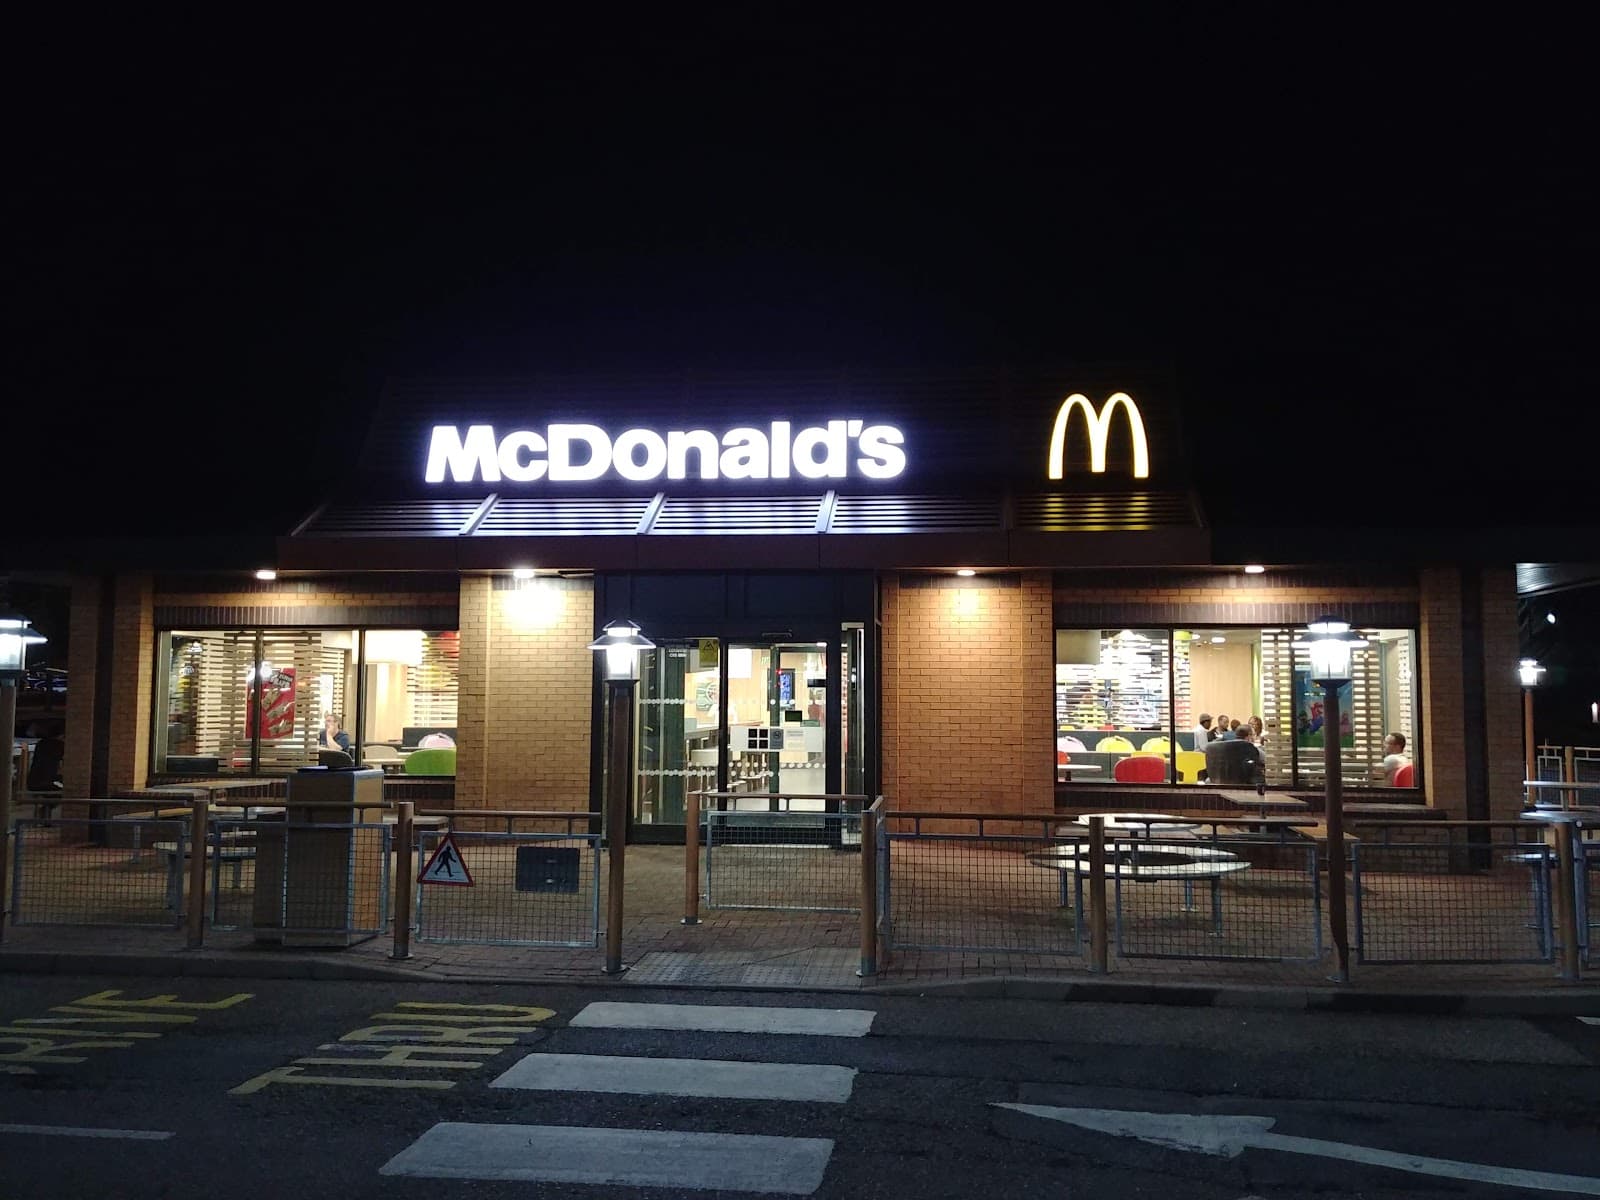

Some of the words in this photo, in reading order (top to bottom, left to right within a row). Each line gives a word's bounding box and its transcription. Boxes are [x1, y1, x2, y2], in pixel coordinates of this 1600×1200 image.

[424, 419, 906, 483] McDonald's
[0, 989, 257, 1075] RIVE
[226, 1000, 557, 1095] THRU
